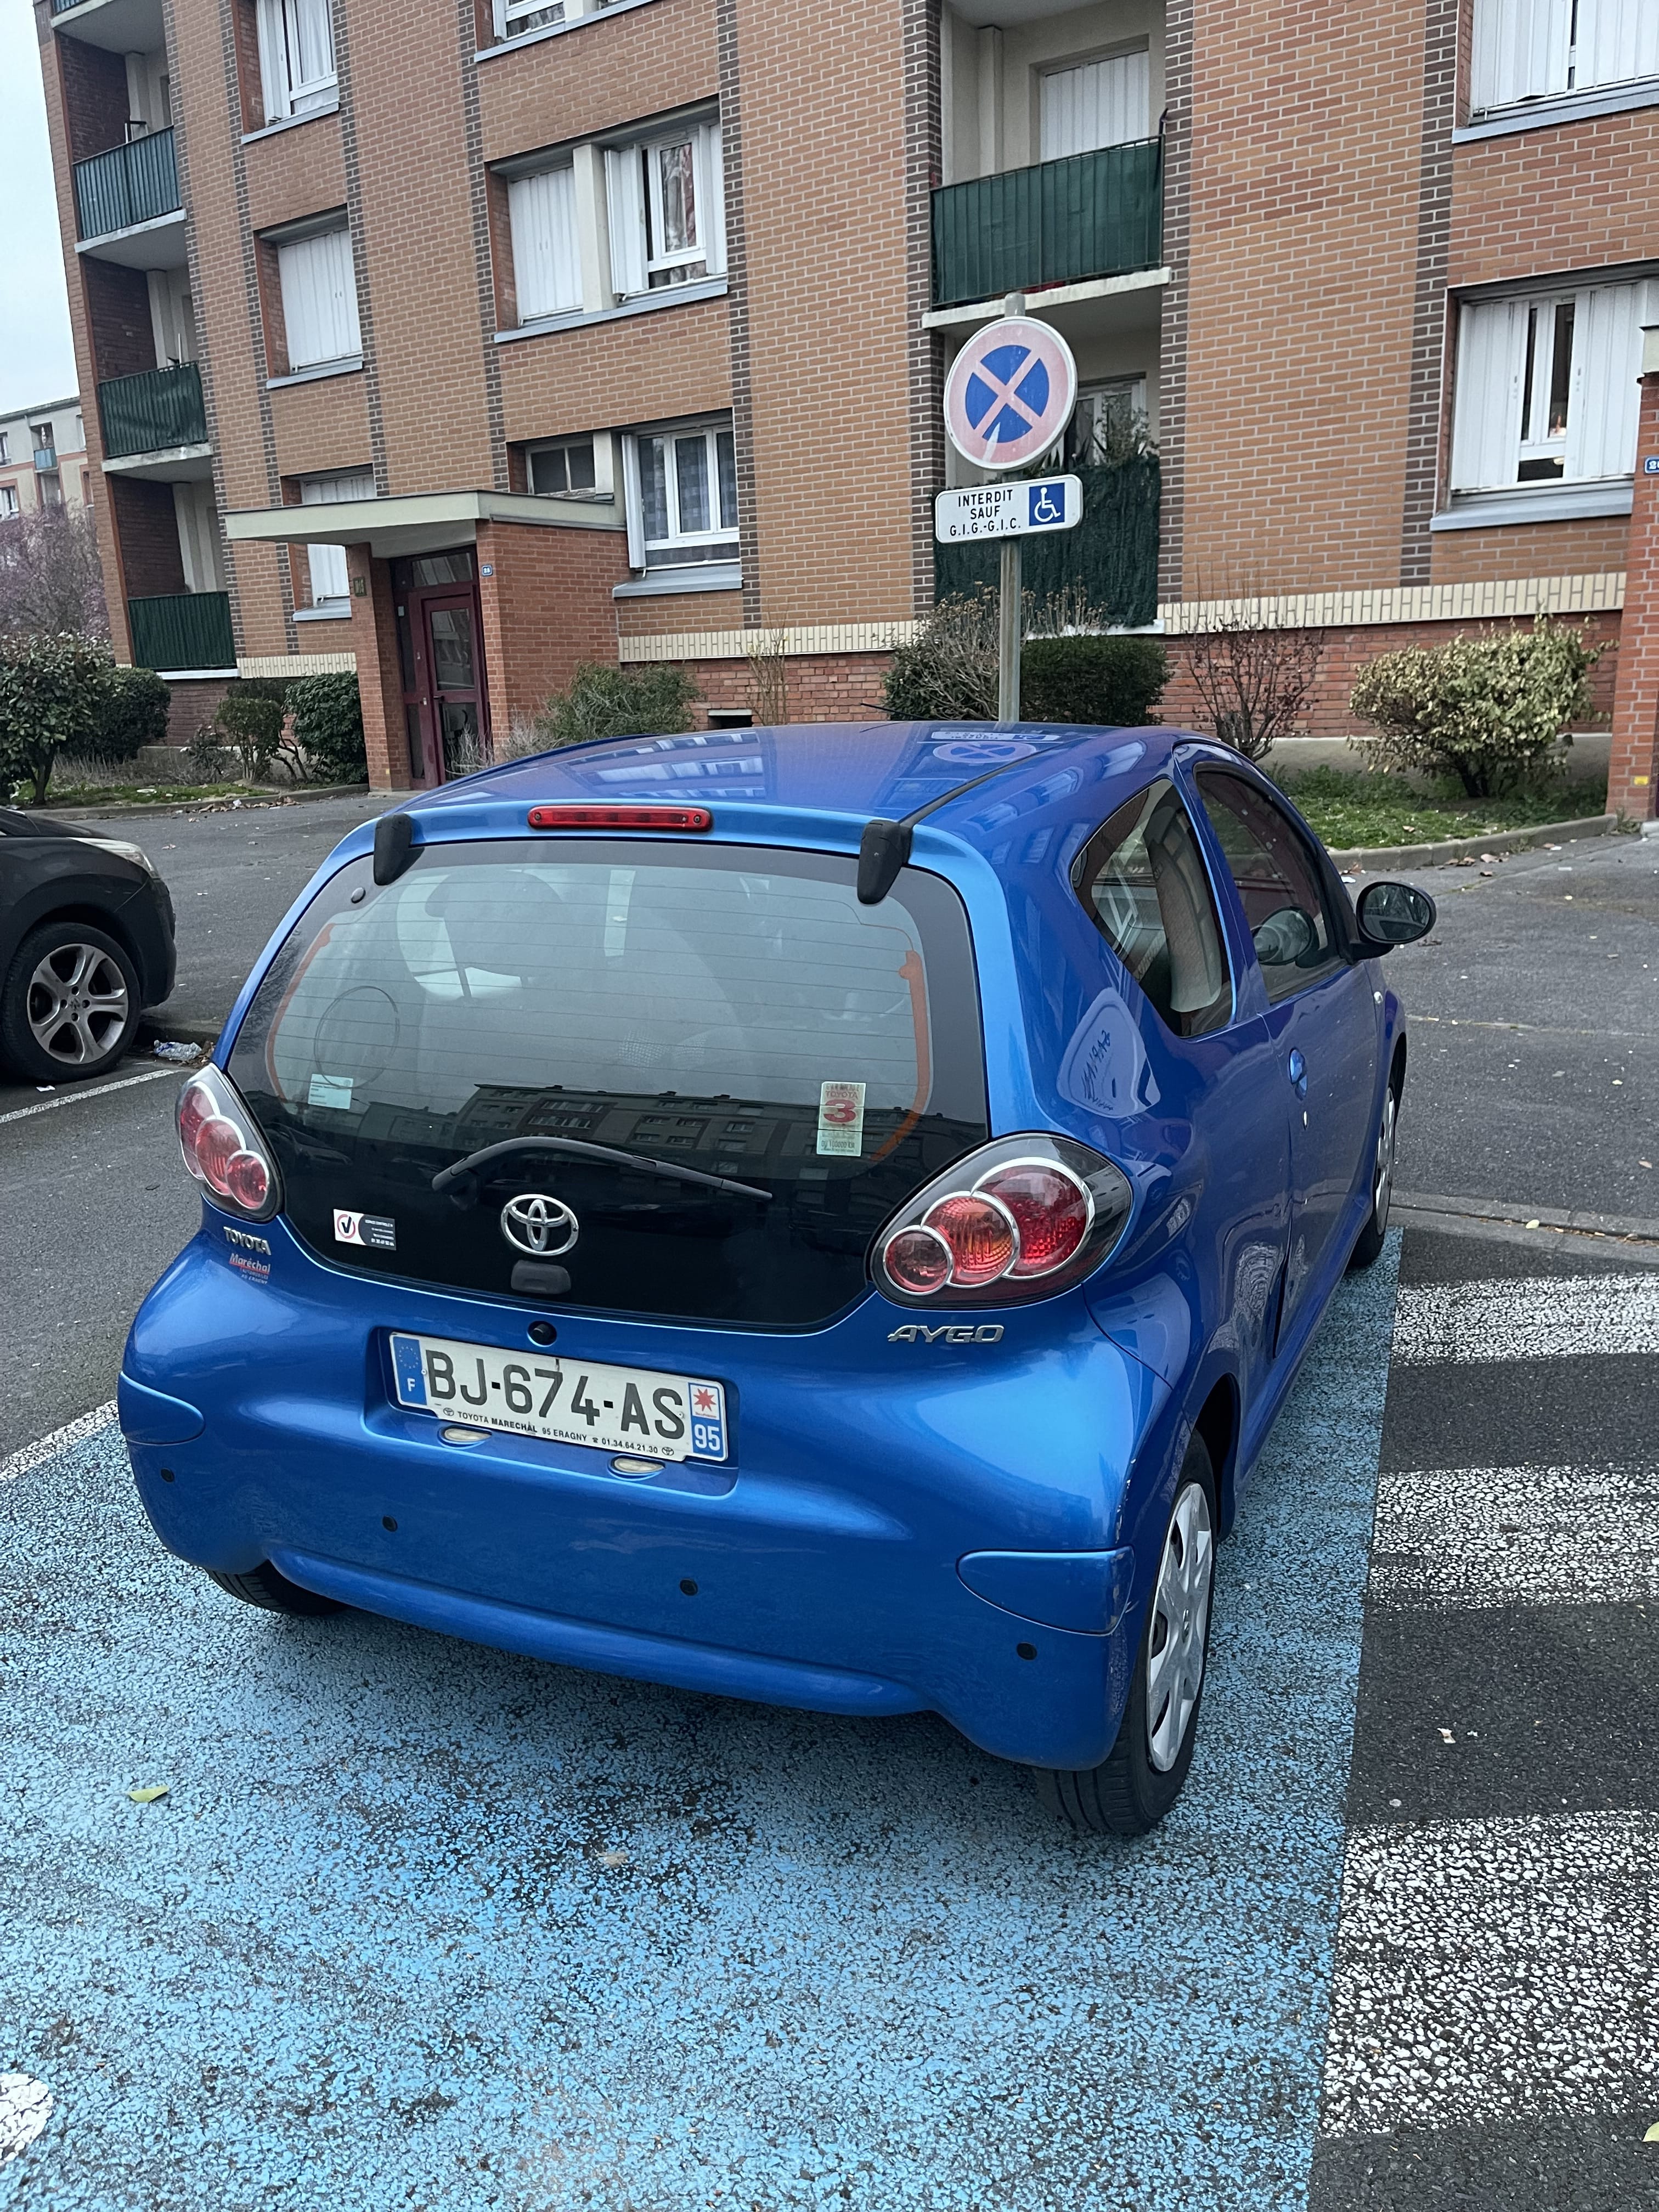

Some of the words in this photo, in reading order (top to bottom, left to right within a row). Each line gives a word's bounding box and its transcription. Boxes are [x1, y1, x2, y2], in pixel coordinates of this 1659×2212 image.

[958, 489, 1013, 507] INTERDIT
[970, 505, 1000, 520] SAUF
[950, 518, 1021, 536] G.I.G.-G.I.C.
[823, 1099, 856, 1123] 3
[223, 1226, 271, 1255] TOYOTA
[230, 1252, 271, 1273] Maréchal
[887, 1325, 1005, 1343] AYGO
[408, 1378, 416, 1392] F
[425, 1349, 685, 1440] BJ-674-AS
[457, 1411, 489, 1424] TOYOTA
[543, 1427, 551, 1436] 95
[554, 1429, 587, 1442] ERAGNY
[602, 1437, 658, 1454] 01.34.64.21.30
[694, 1424, 721, 1451] 95
